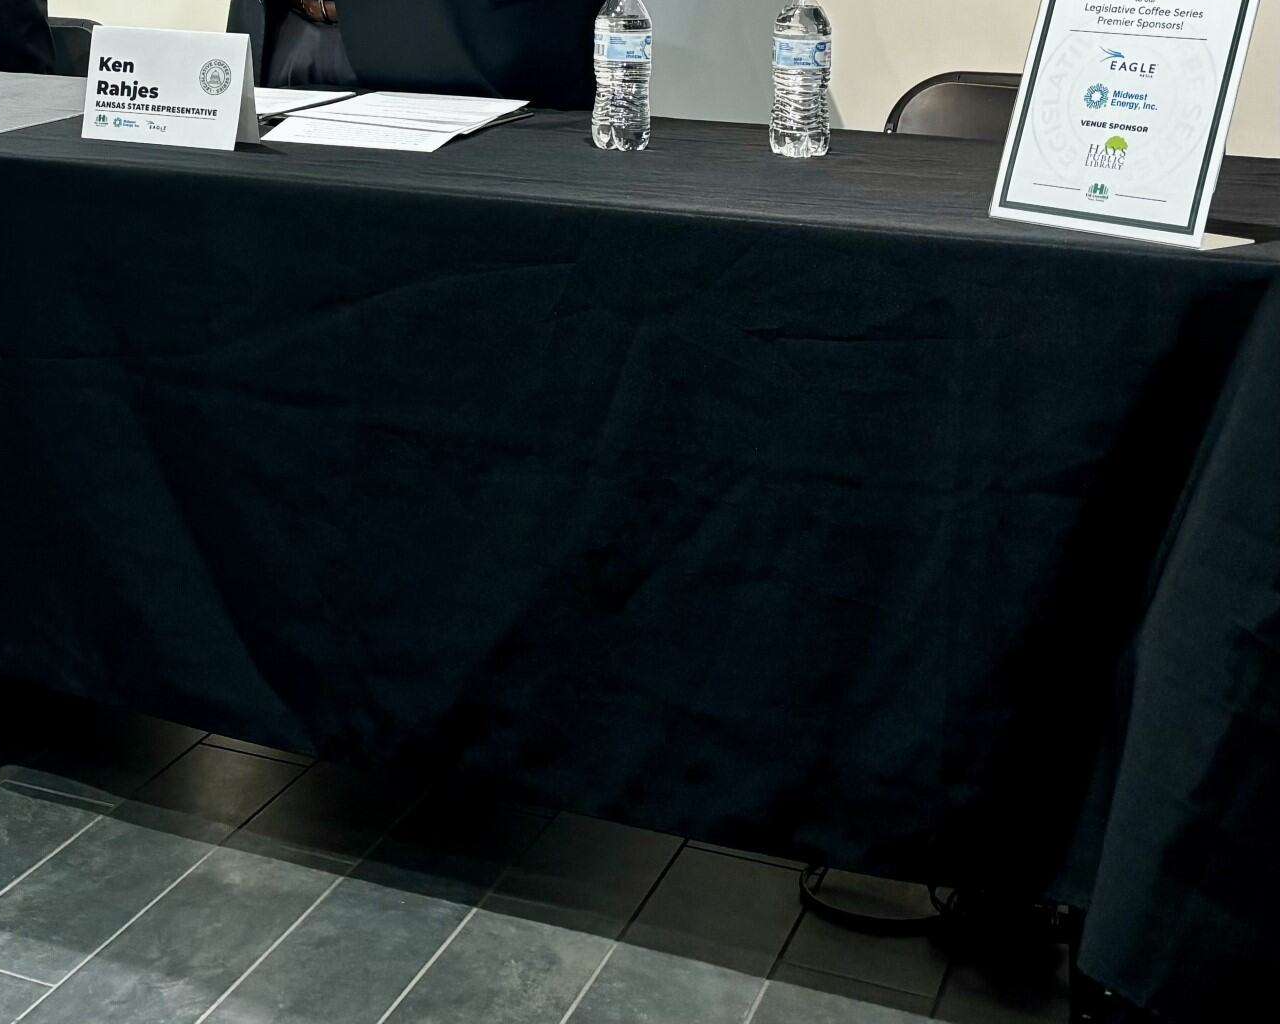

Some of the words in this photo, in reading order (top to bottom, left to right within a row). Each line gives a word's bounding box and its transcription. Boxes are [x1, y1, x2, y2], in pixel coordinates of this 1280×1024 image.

[1084, 3, 1136, 15] Legislative
[1138, 6, 1171, 17] Coffee
[1173, 8, 1204, 19] Series
[1097, 16, 1134, 27] Premier
[1136, 18, 1184, 31] Sponsors!
[99, 56, 135, 74] Ken
[1110, 60, 1157, 74] EAGLE
[97, 80, 158, 101] Rahjes
[1112, 90, 1148, 101] Midwest
[95, 100, 126, 110] KANSAS
[127, 102, 150, 112] STATE
[151, 105, 218, 117] REPRESENTATIVE
[1110, 98, 1141, 110] Energy,
[1142, 102, 1158, 111] Inc.
[1080, 119, 1107, 129] VENUE
[1109, 123, 1149, 133] SPONSOR
